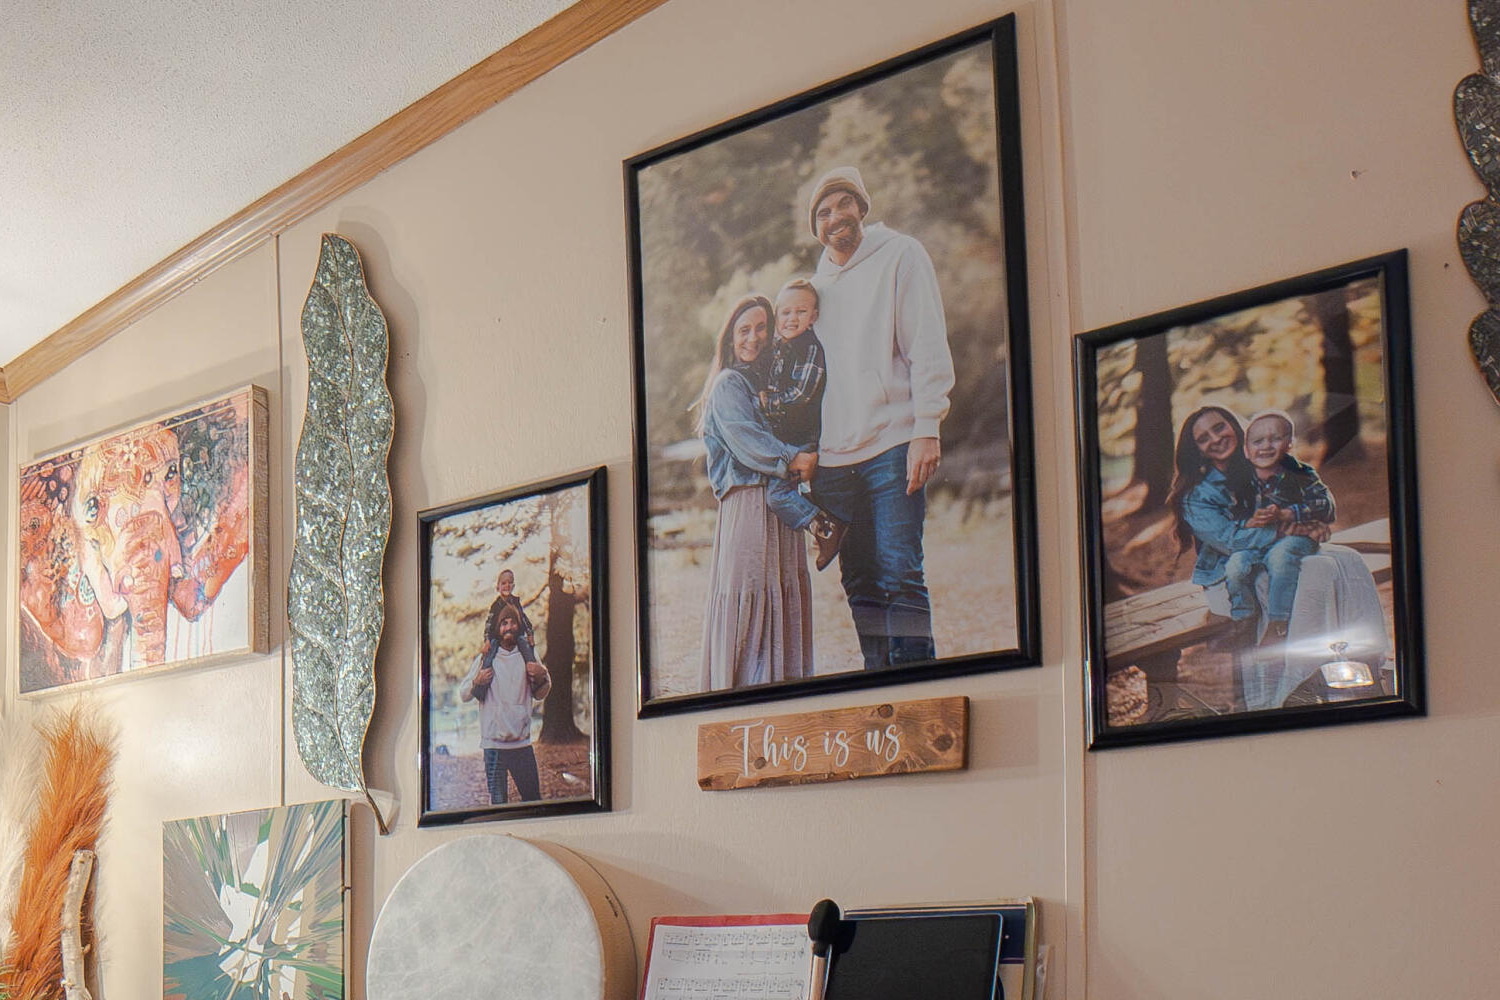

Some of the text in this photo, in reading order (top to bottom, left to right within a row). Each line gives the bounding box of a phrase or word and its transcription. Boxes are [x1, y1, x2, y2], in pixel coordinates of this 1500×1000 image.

[730, 719, 903, 777] This is us
